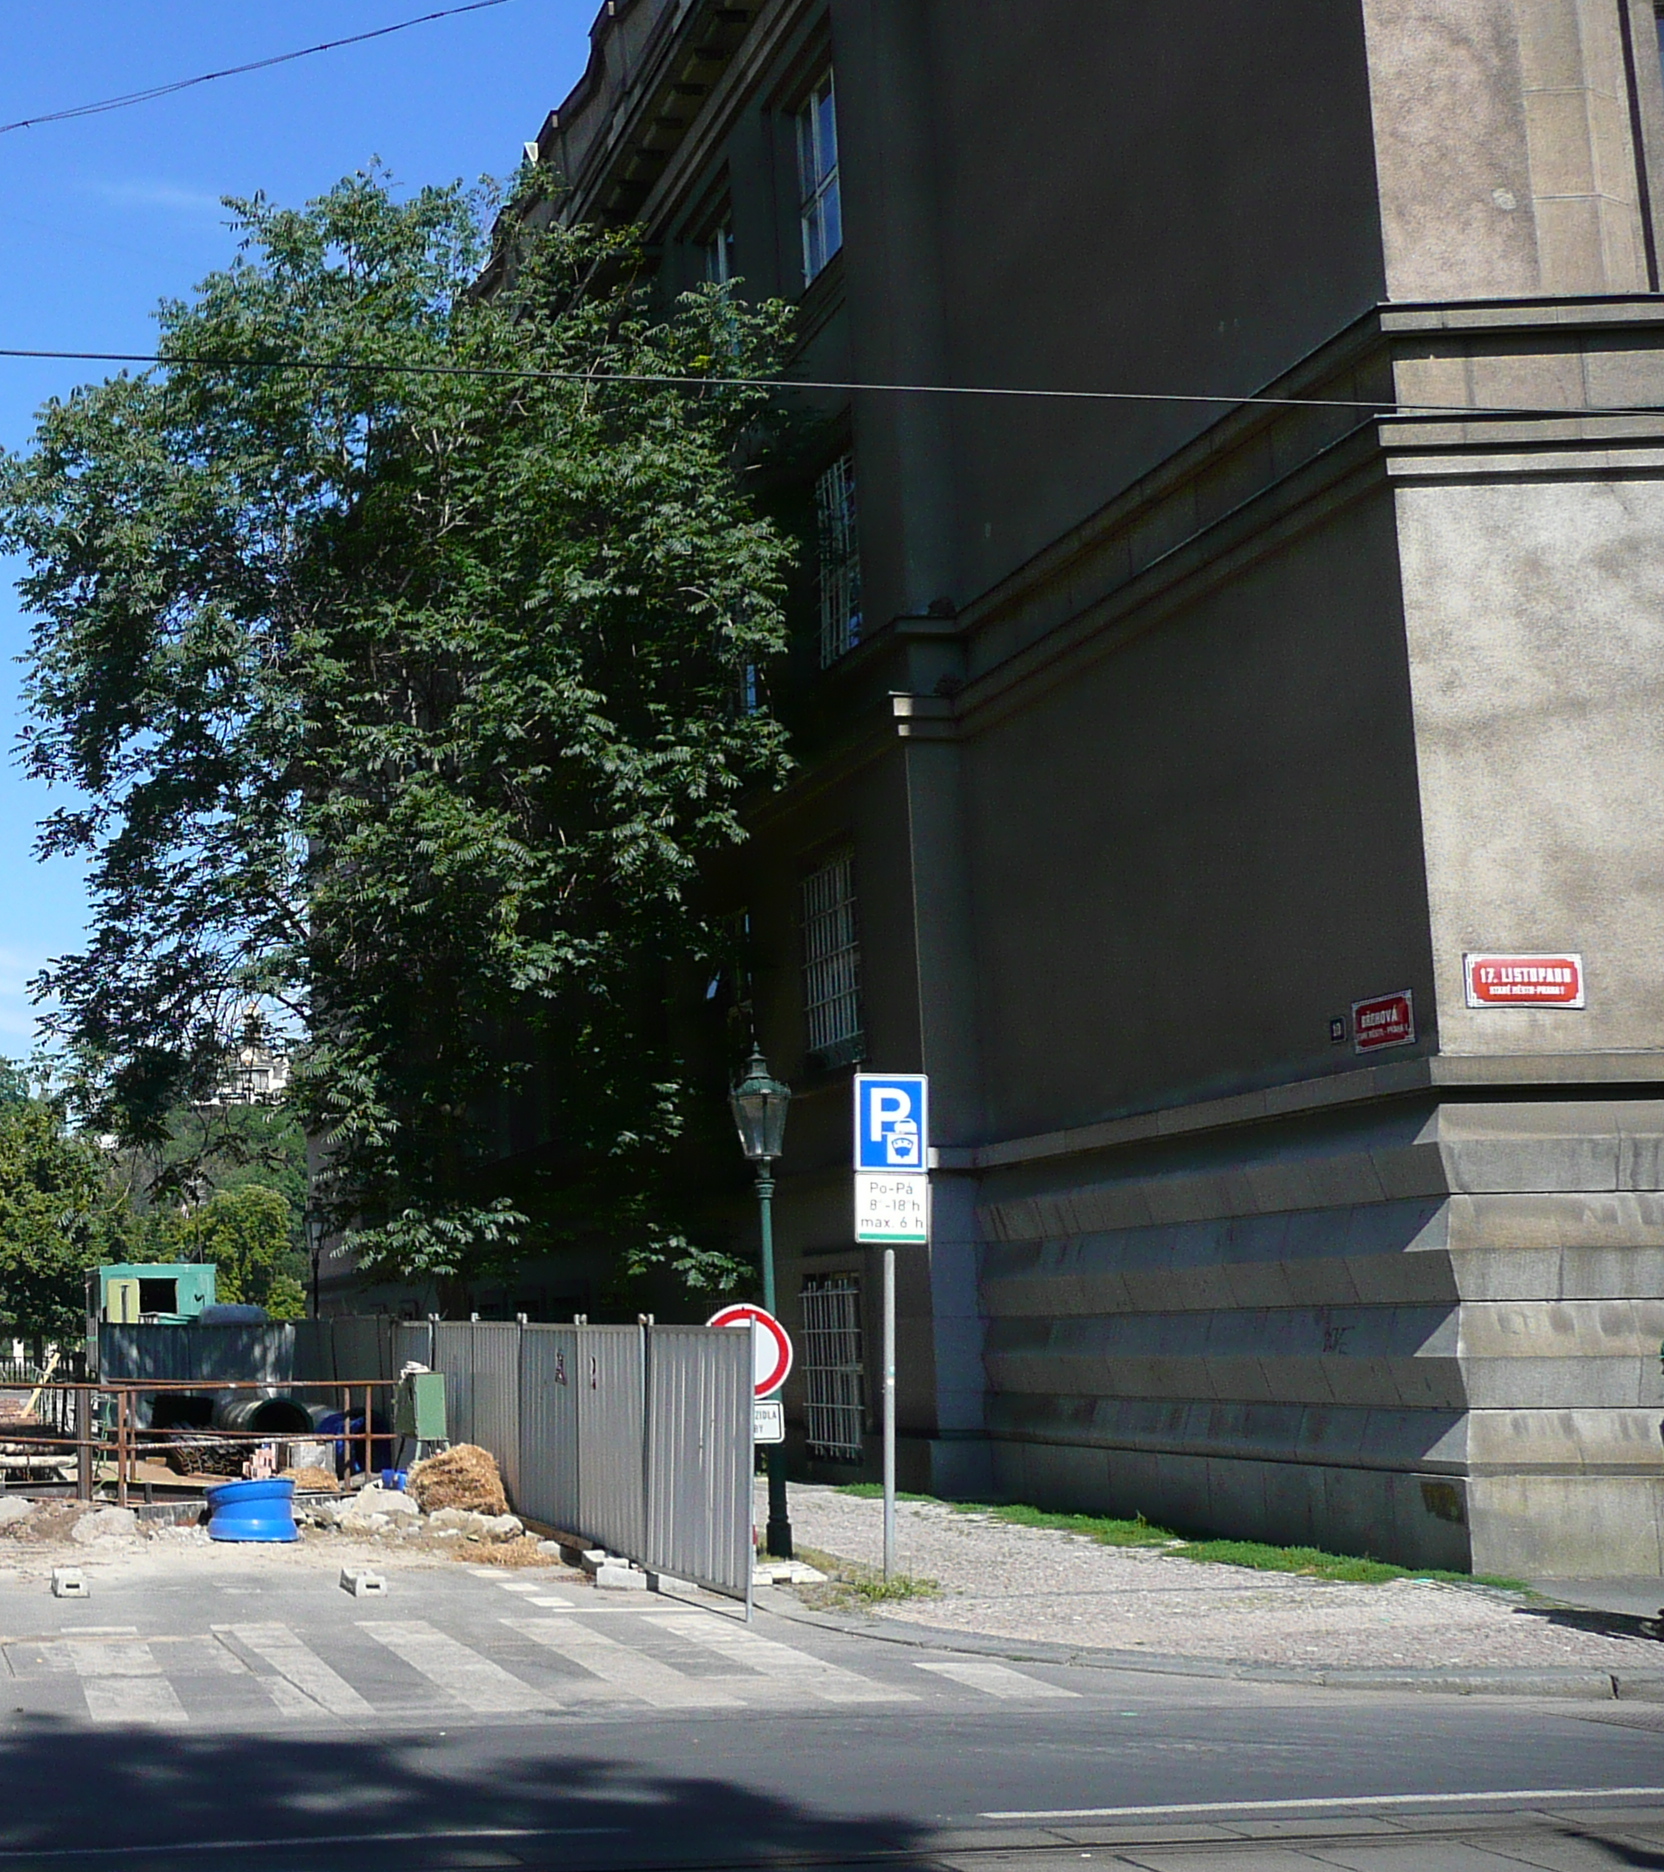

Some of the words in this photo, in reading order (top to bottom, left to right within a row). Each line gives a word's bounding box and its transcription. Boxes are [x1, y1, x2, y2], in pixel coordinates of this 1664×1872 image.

[1480, 967, 1499, 983] 17.
[870, 1087, 911, 1142] P
[870, 1181, 913, 1195] Po-Pá
[900, 1216, 907, 1228] 6
[915, 1216, 923, 1229] h
[755, 1410, 777, 1420] ZIDLA
